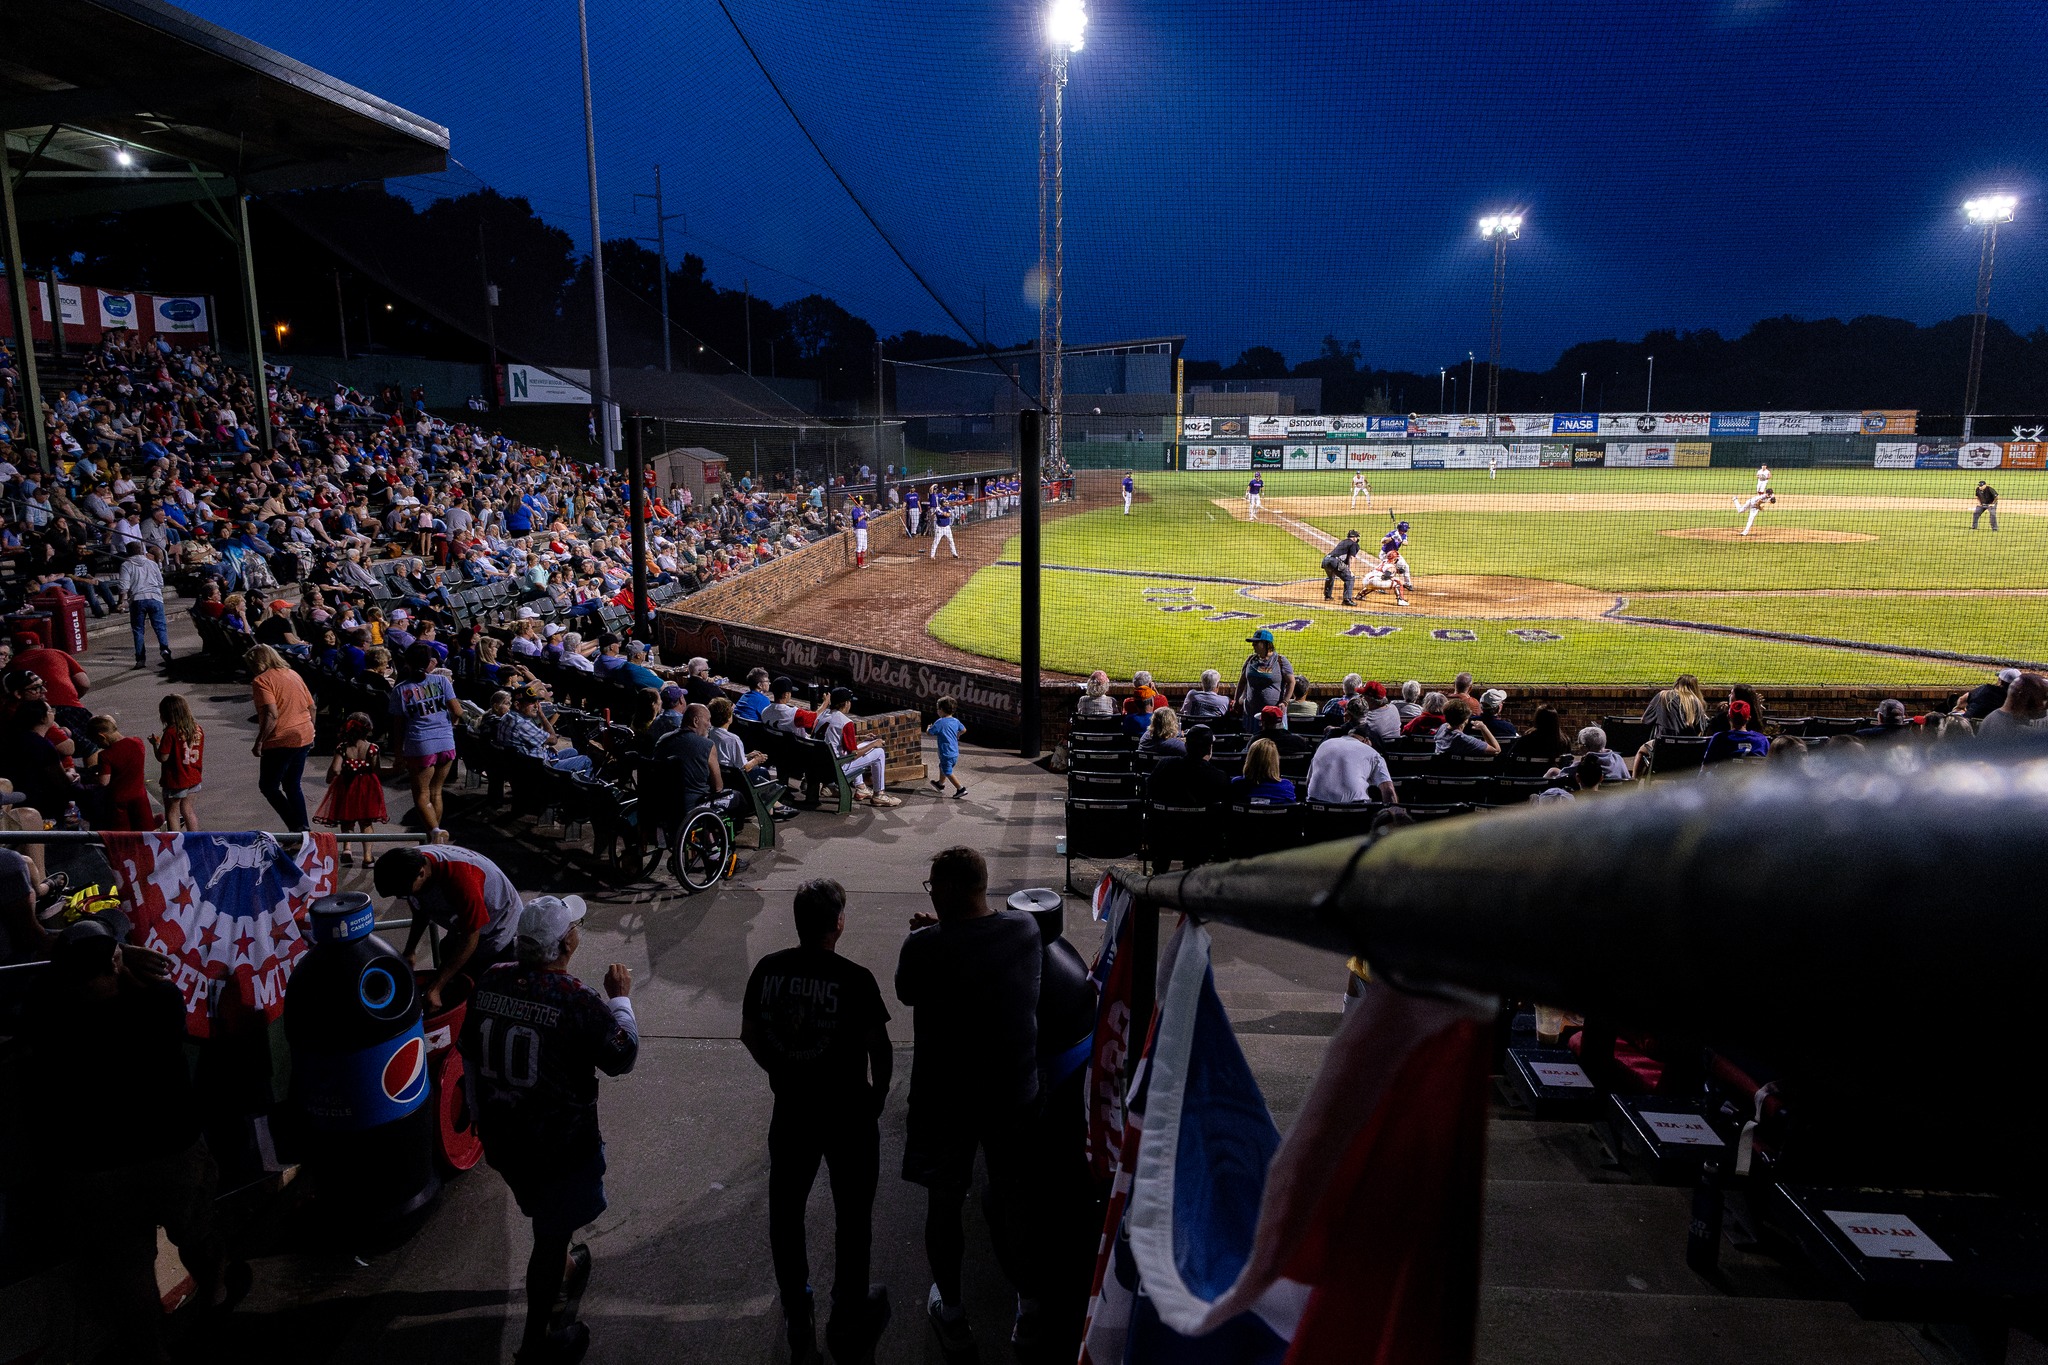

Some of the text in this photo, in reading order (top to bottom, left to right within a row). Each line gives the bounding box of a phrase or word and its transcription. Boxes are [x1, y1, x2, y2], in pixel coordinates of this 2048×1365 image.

[1297, 419, 1325, 428] snorkel
[1565, 420, 1594, 430] NASB
[1665, 414, 1709, 424] SAV-ON
[2010, 444, 2037, 452] HIT IT
[72, 611, 82, 652] RECYCLE
[732, 634, 766, 651] Welcome
[780, 638, 820, 668] Phil
[849, 652, 914, 690] Welch
[915, 665, 1013, 710] Stadium
[183, 742, 200, 765] 15
[761, 976, 840, 1014] MY GUNS
[480, 1016, 541, 1089] 10
[1541, 1069, 1579, 1080] HY-VEE
[1655, 1121, 1704, 1134] HY-VEE
[1848, 1225, 1917, 1237] HY-VEE
